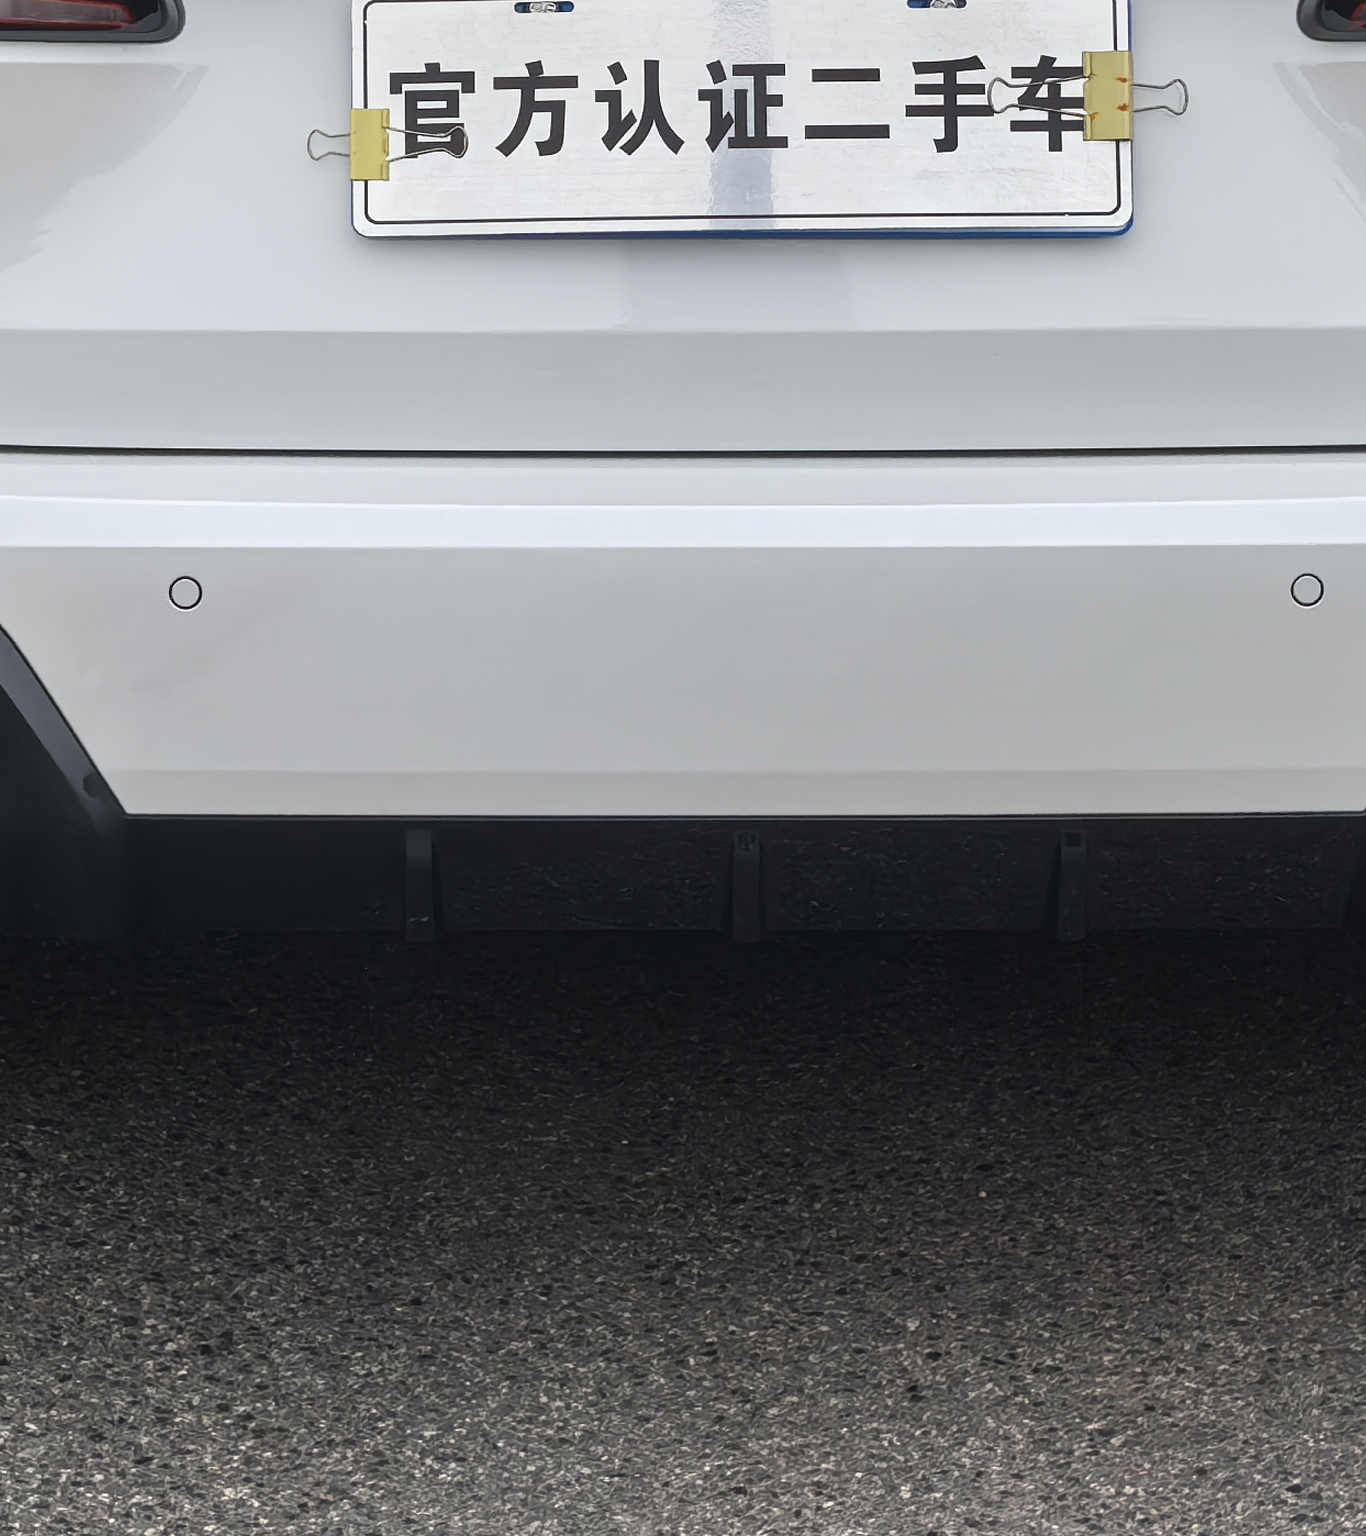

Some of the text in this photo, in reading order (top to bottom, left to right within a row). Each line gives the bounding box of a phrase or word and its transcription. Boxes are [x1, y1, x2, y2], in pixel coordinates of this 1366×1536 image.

[388, 55, 1085, 159] 官方认证二手车
